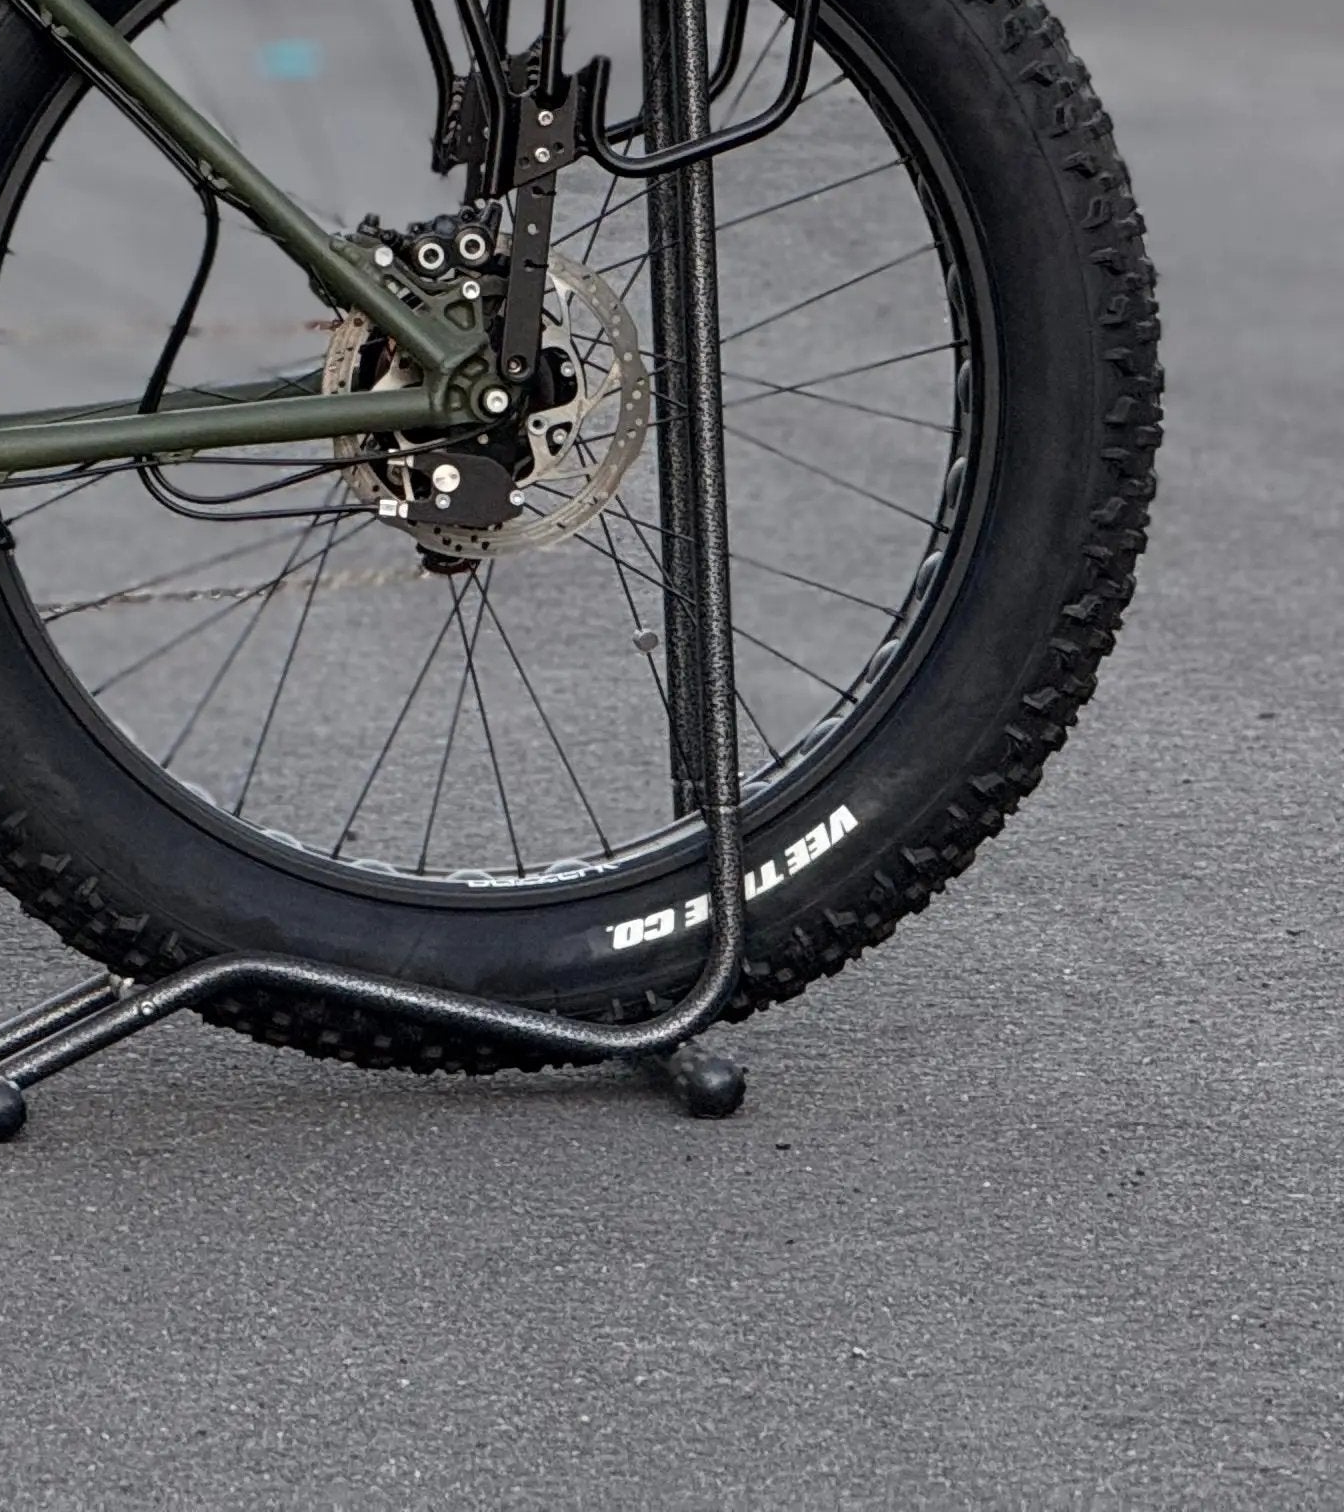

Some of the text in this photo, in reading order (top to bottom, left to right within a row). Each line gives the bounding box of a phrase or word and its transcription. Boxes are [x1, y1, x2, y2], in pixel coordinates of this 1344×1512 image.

[606, 804, 859, 951] VEE TIE CO.
